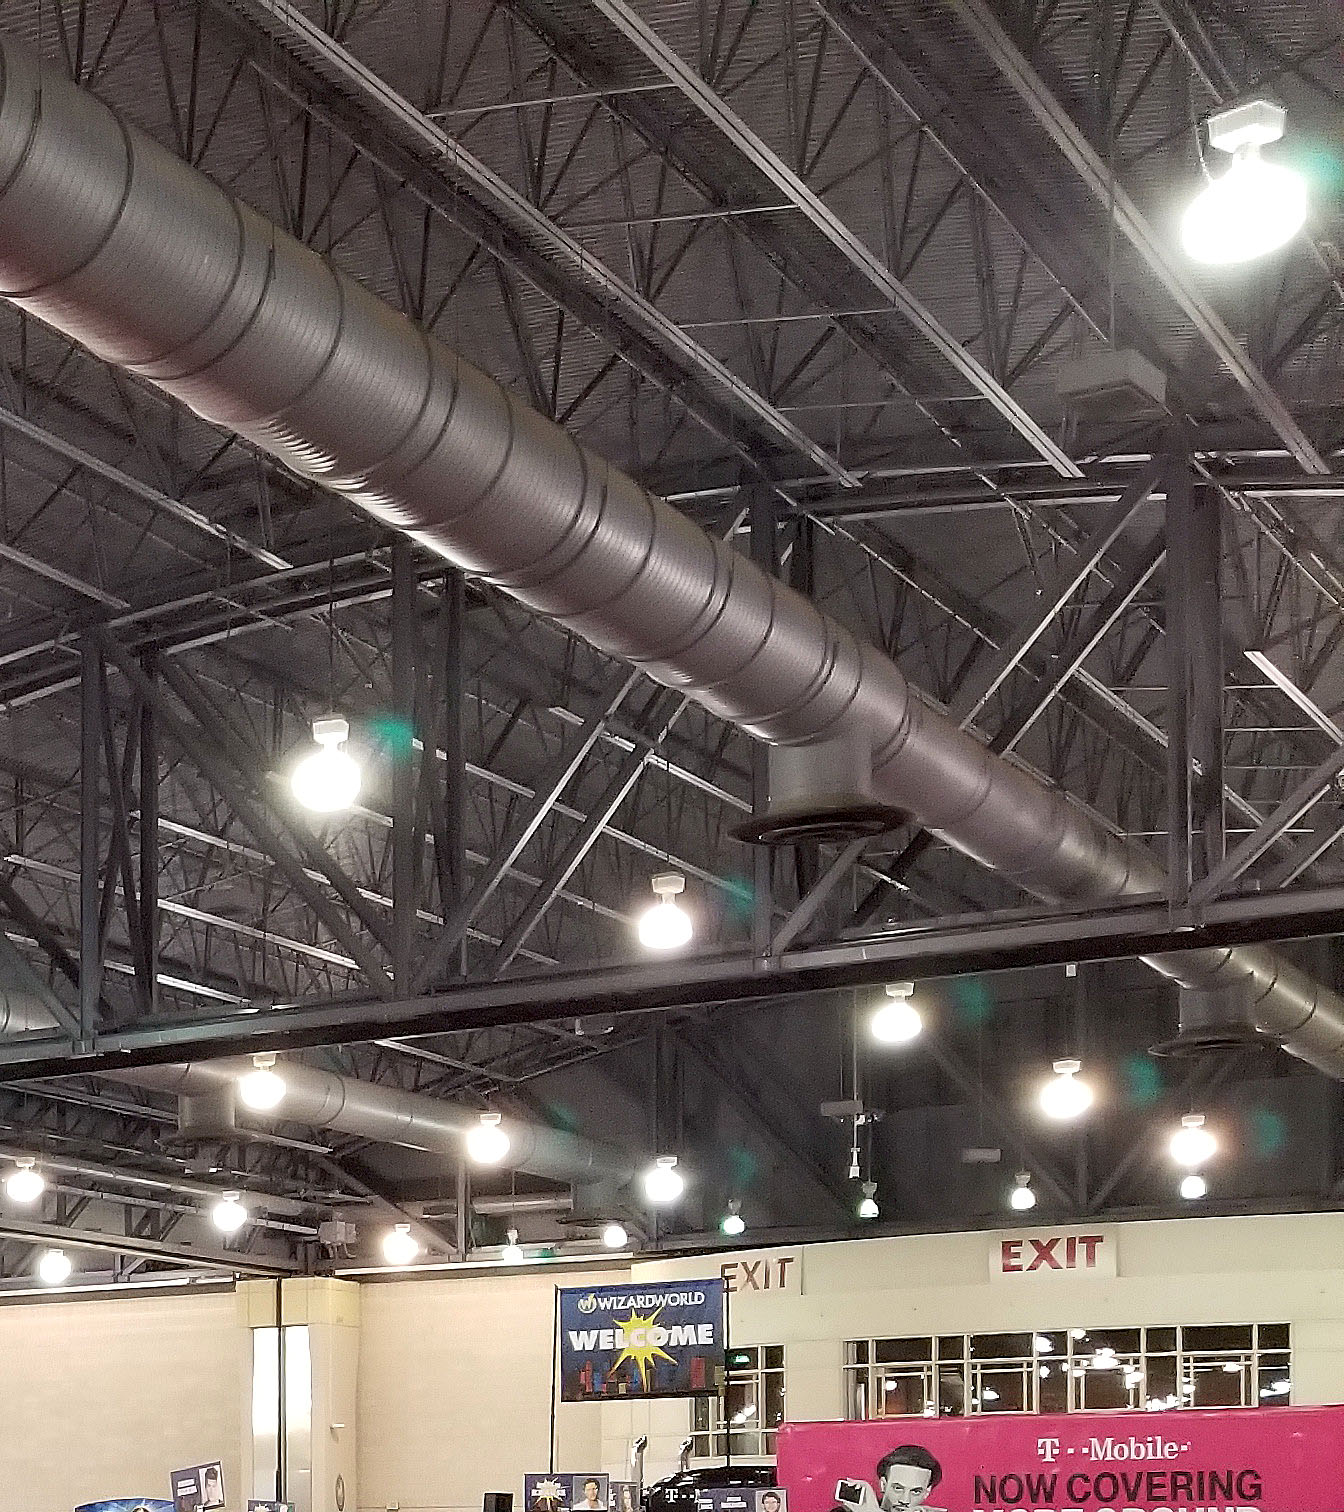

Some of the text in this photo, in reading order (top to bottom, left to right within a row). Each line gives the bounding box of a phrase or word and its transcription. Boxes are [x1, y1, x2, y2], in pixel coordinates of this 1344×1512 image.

[1001, 1234, 1105, 1273] EXIT
[720, 1257, 795, 1293] EXIT
[597, 1291, 705, 1311] WIZARDWORLD
[568, 1323, 714, 1351] WELCOME
[973, 1469, 1263, 1505] NOW COVERING
